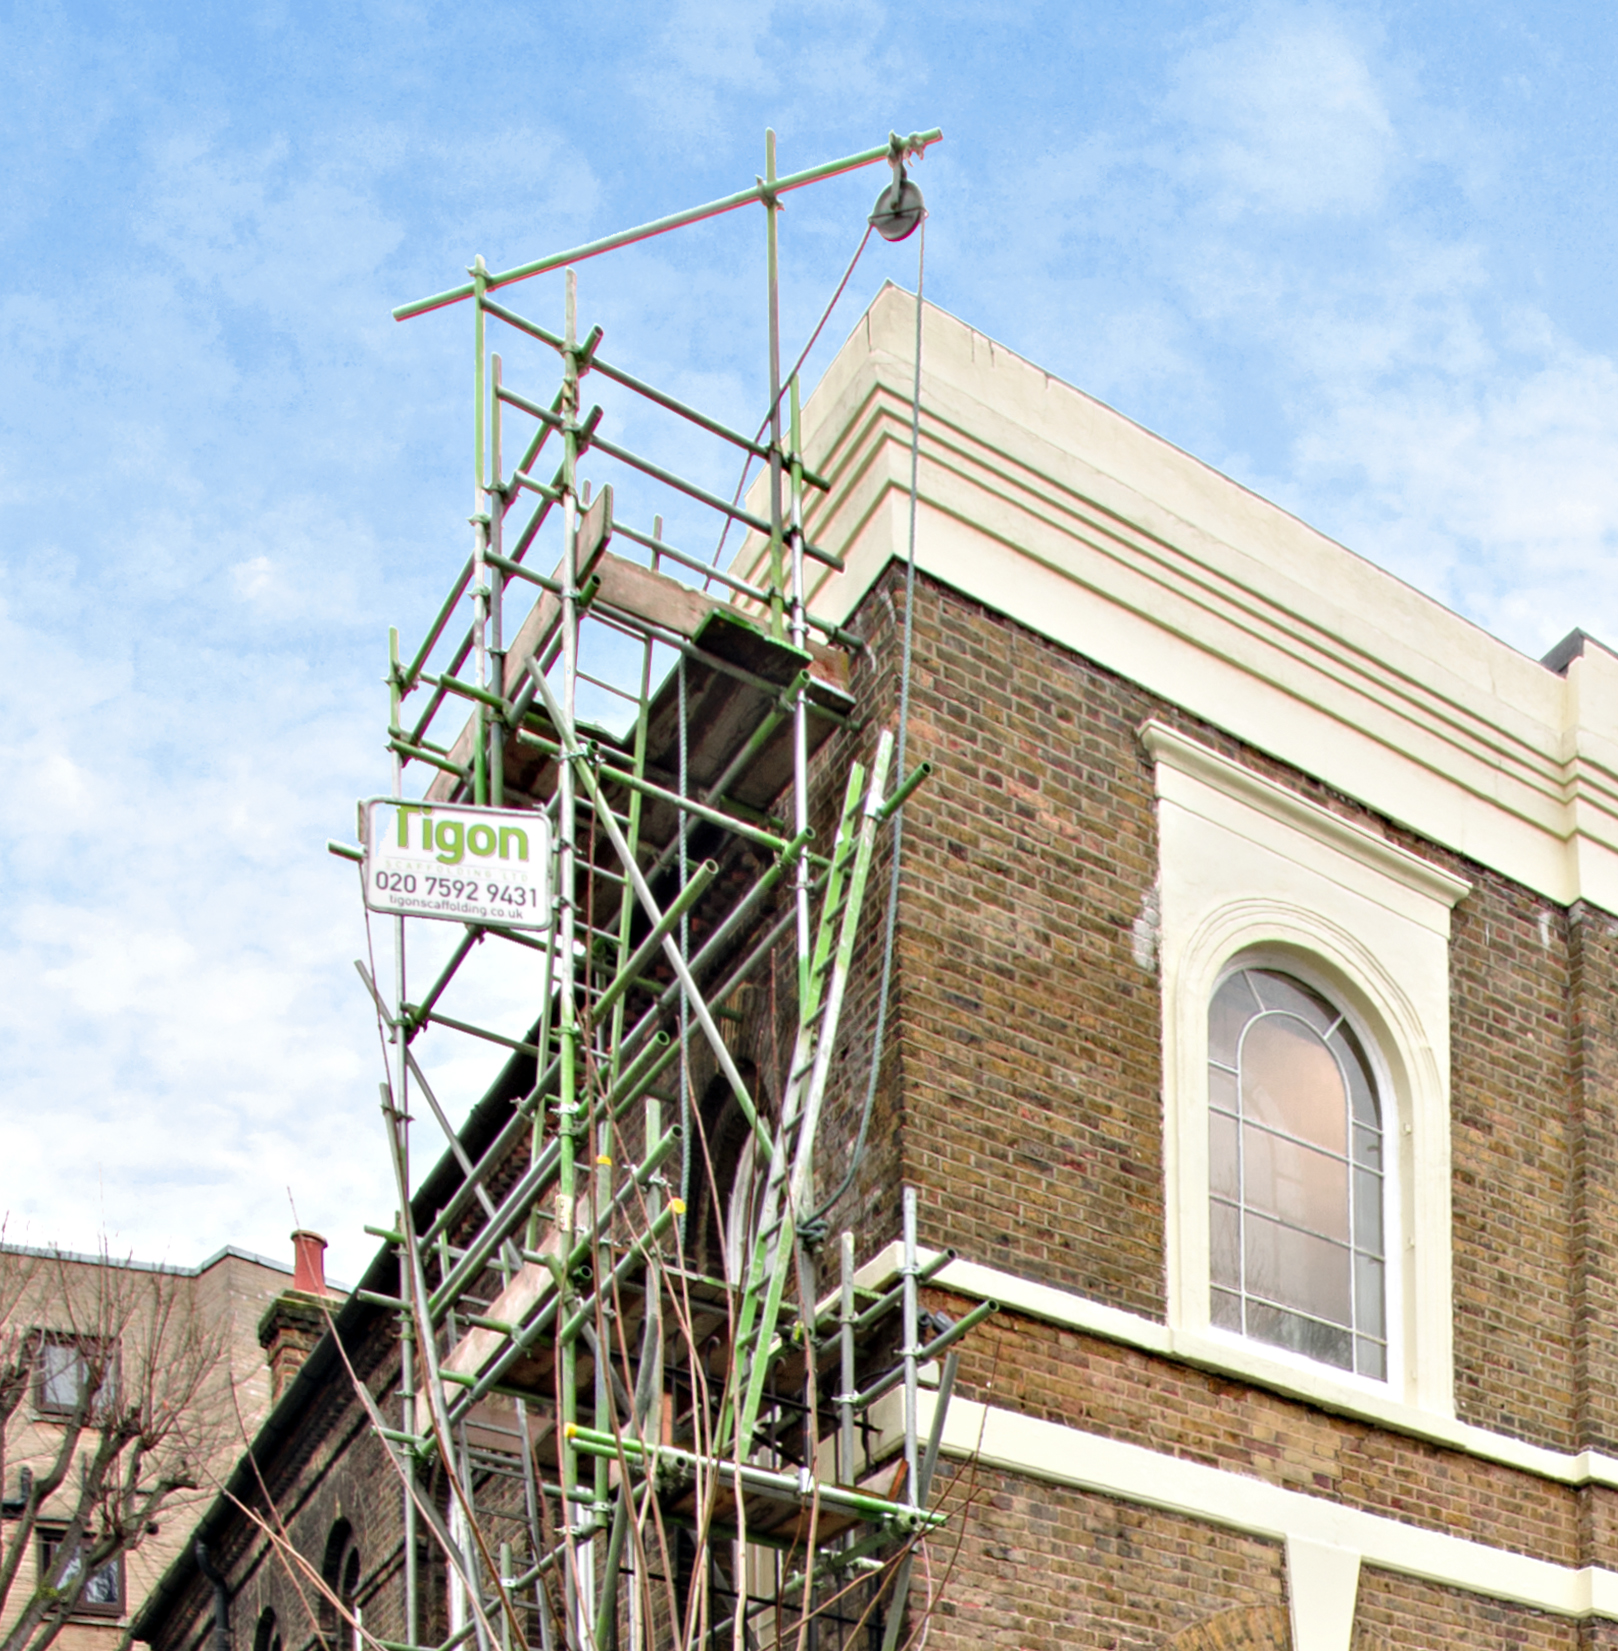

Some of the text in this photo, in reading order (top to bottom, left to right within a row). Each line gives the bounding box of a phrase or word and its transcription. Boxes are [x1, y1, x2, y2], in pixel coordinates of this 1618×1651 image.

[396, 806, 529, 864] Tigon
[385, 860, 529, 883] SCAFFOLDING LTD
[376, 871, 536, 908] 020 7592 9431
[389, 894, 524, 919] tigonscaffolding.co.uk
